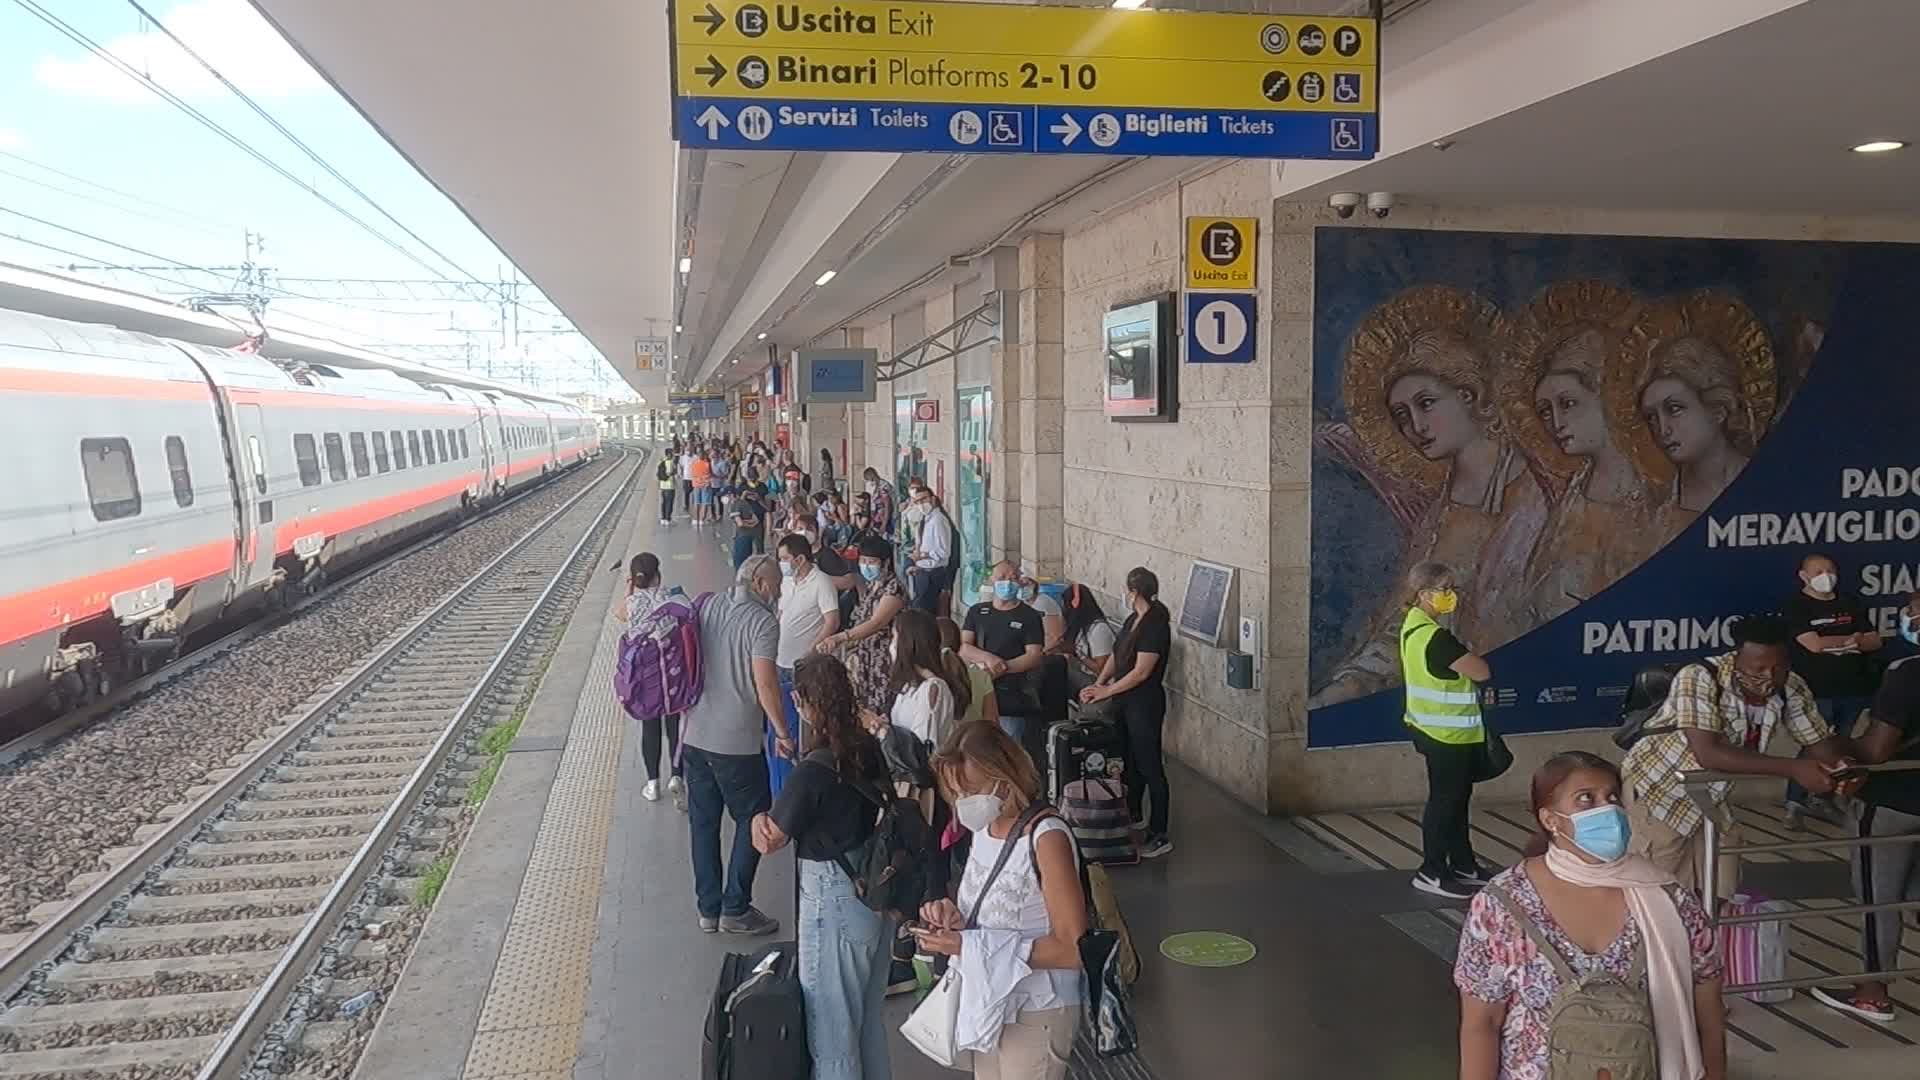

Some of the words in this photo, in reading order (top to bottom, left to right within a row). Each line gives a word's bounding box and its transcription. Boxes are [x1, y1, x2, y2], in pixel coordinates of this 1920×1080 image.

[777, 5, 876, 33] Uscita
[888, 9, 934, 36] Exit
[777, 56, 877, 85] Binari
[889, 59, 1009, 88] Platforms
[1019, 63, 1097, 90] 2-10
[779, 106, 858, 127] Servizi
[870, 108, 929, 128] Toilets
[1125, 113, 1208, 137] Biglietti
[1219, 115, 1275, 135] Tickets
[1194, 269, 1228, 280] Uscita
[1213, 311, 1226, 344] 1
[1860, 562, 1920, 596] SIA
